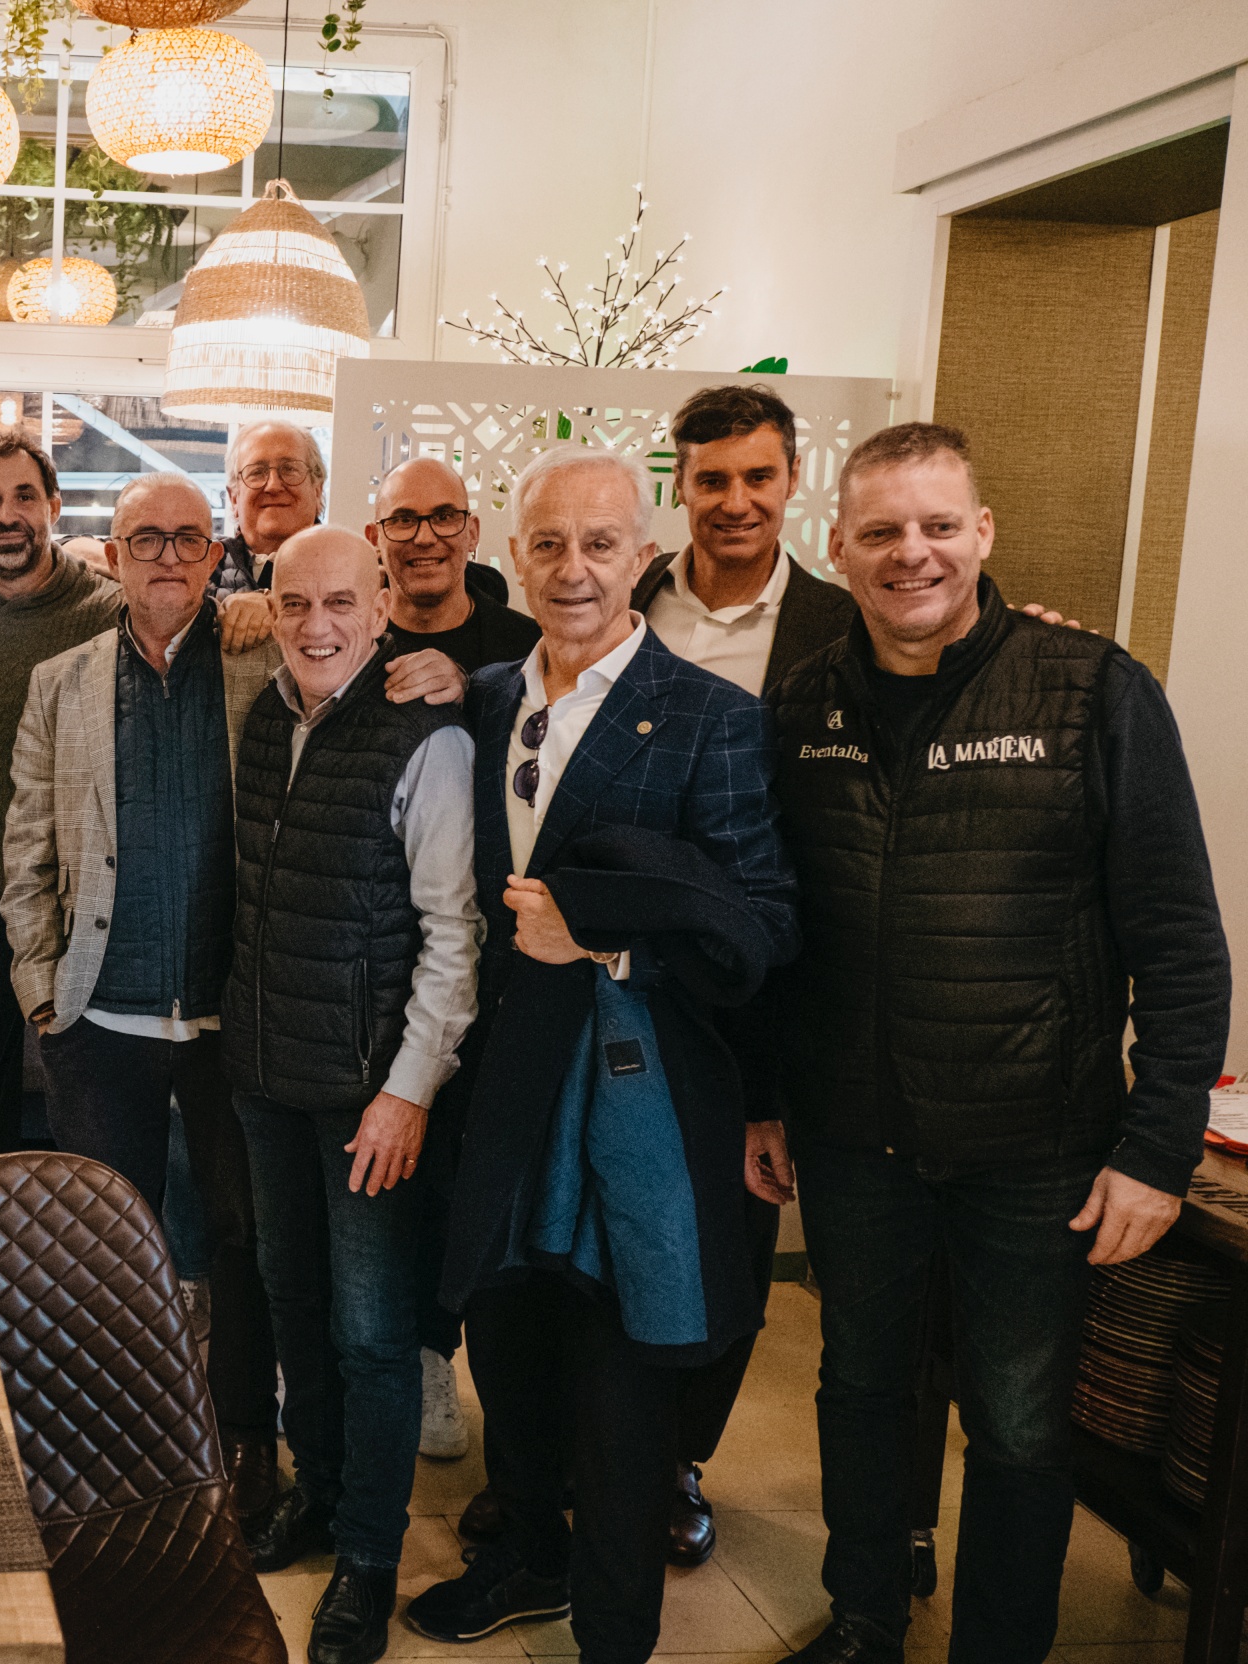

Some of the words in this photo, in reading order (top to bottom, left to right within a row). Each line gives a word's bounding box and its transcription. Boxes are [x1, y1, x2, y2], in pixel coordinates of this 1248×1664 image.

[799, 744, 869, 764] Eventalba
[927, 742, 951, 770] LA
[954, 735, 1046, 763] MARTEÑA
